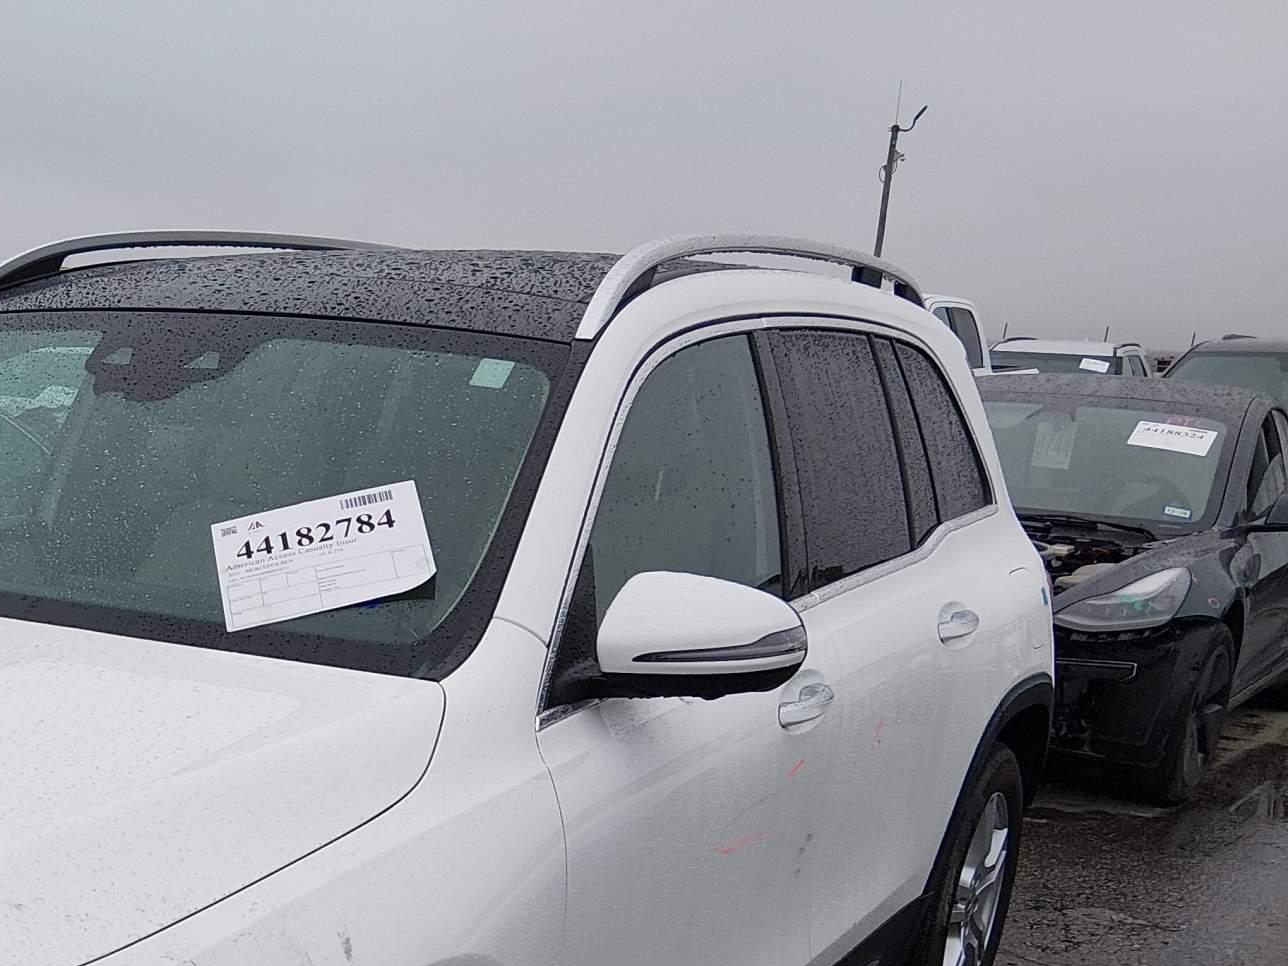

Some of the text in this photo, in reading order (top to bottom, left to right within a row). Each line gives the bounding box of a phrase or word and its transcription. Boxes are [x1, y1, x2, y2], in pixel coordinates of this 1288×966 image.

[226, 538, 358, 572] American Access Casualty Insur
[236, 508, 396, 560] 44182784
